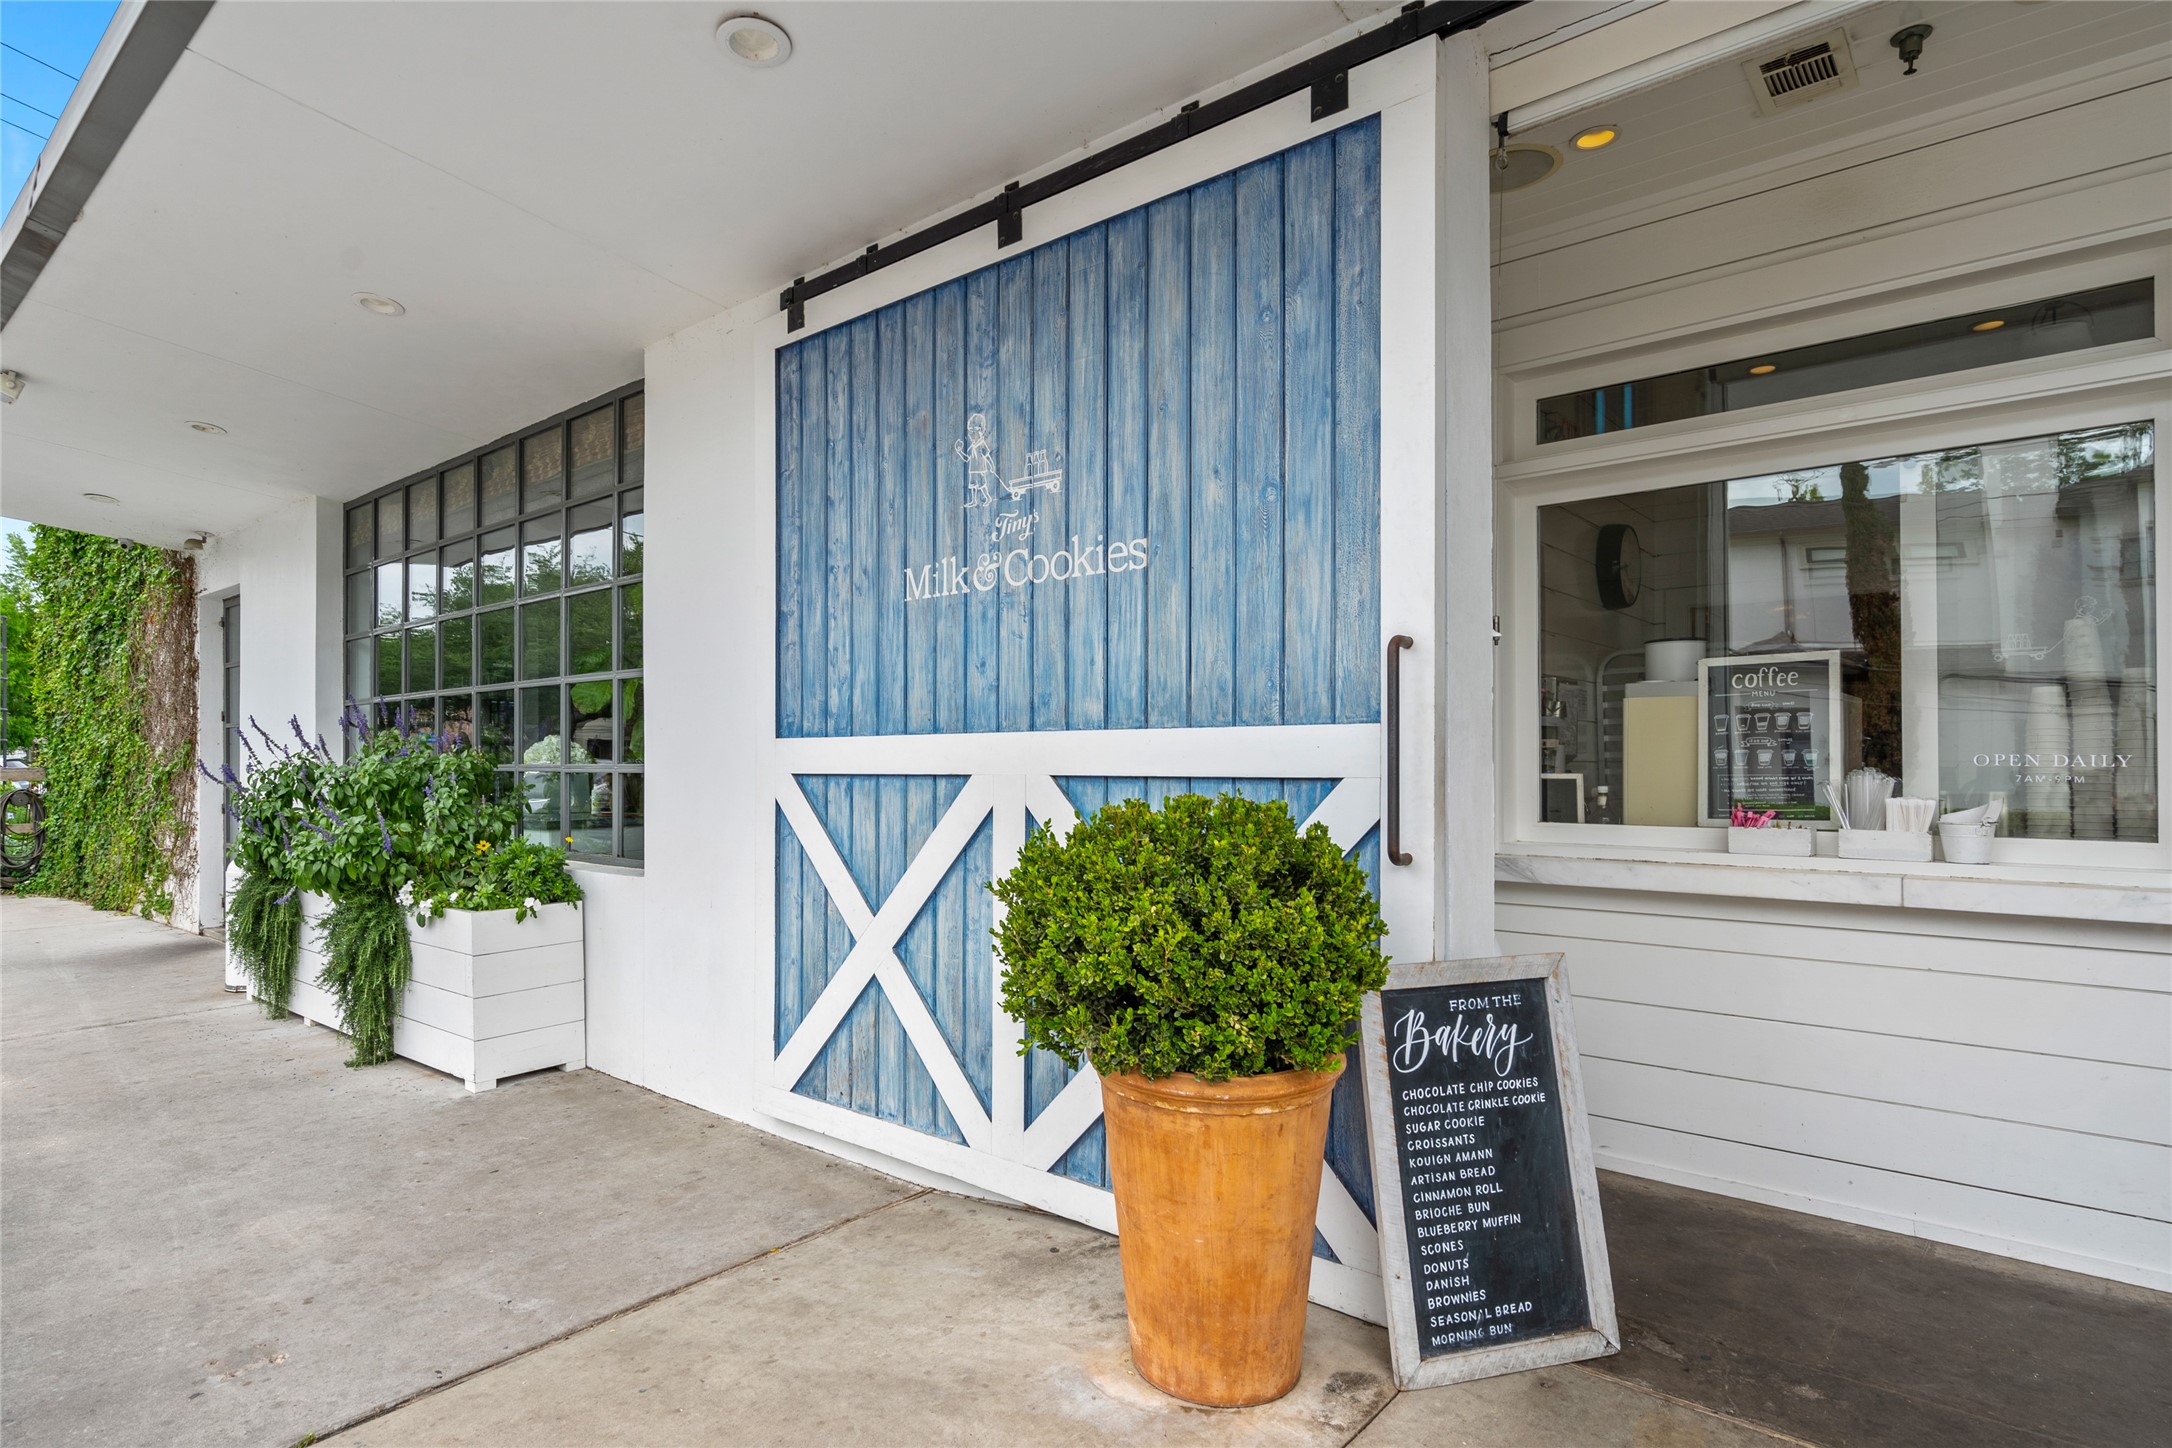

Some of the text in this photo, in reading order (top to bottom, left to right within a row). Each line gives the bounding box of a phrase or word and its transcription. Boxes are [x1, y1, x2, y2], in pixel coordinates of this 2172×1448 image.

[904, 535, 1149, 602] Milk & Cookies
[1731, 667, 1799, 688] coffee
[1973, 754, 2132, 768] OPEN DAILY
[1449, 994, 1522, 1011] FROM THE
[1393, 1009, 1534, 1077] Bakery
[1402, 1077, 1539, 1101] CHOCOLATE CHIP COOKIES
[1403, 1092, 1546, 1116] CHOCOLATE CRINKLE COOKIE
[1406, 1116, 1485, 1135] SUGAR COOKIE
[1407, 1133, 1475, 1151] CROISSANTS
[1409, 1149, 1493, 1168] KOUIGN AMANN
[1411, 1165, 1495, 1186] ARTISAN BREAD
[1413, 1182, 1503, 1203] CINNAMON ROLL
[1415, 1201, 1490, 1221] BRIOCHE BUN
[1417, 1214, 1521, 1238] BLUEBERRY MUFFIN
[1421, 1240, 1464, 1256] SCONES
[1424, 1258, 1469, 1275] DONUTS
[1426, 1275, 1470, 1291] DANISH
[1428, 1289, 1487, 1310] BROWNIES
[1495, 1301, 1532, 1316] BREAD
[1431, 1323, 1512, 1346] MORNING BUN
